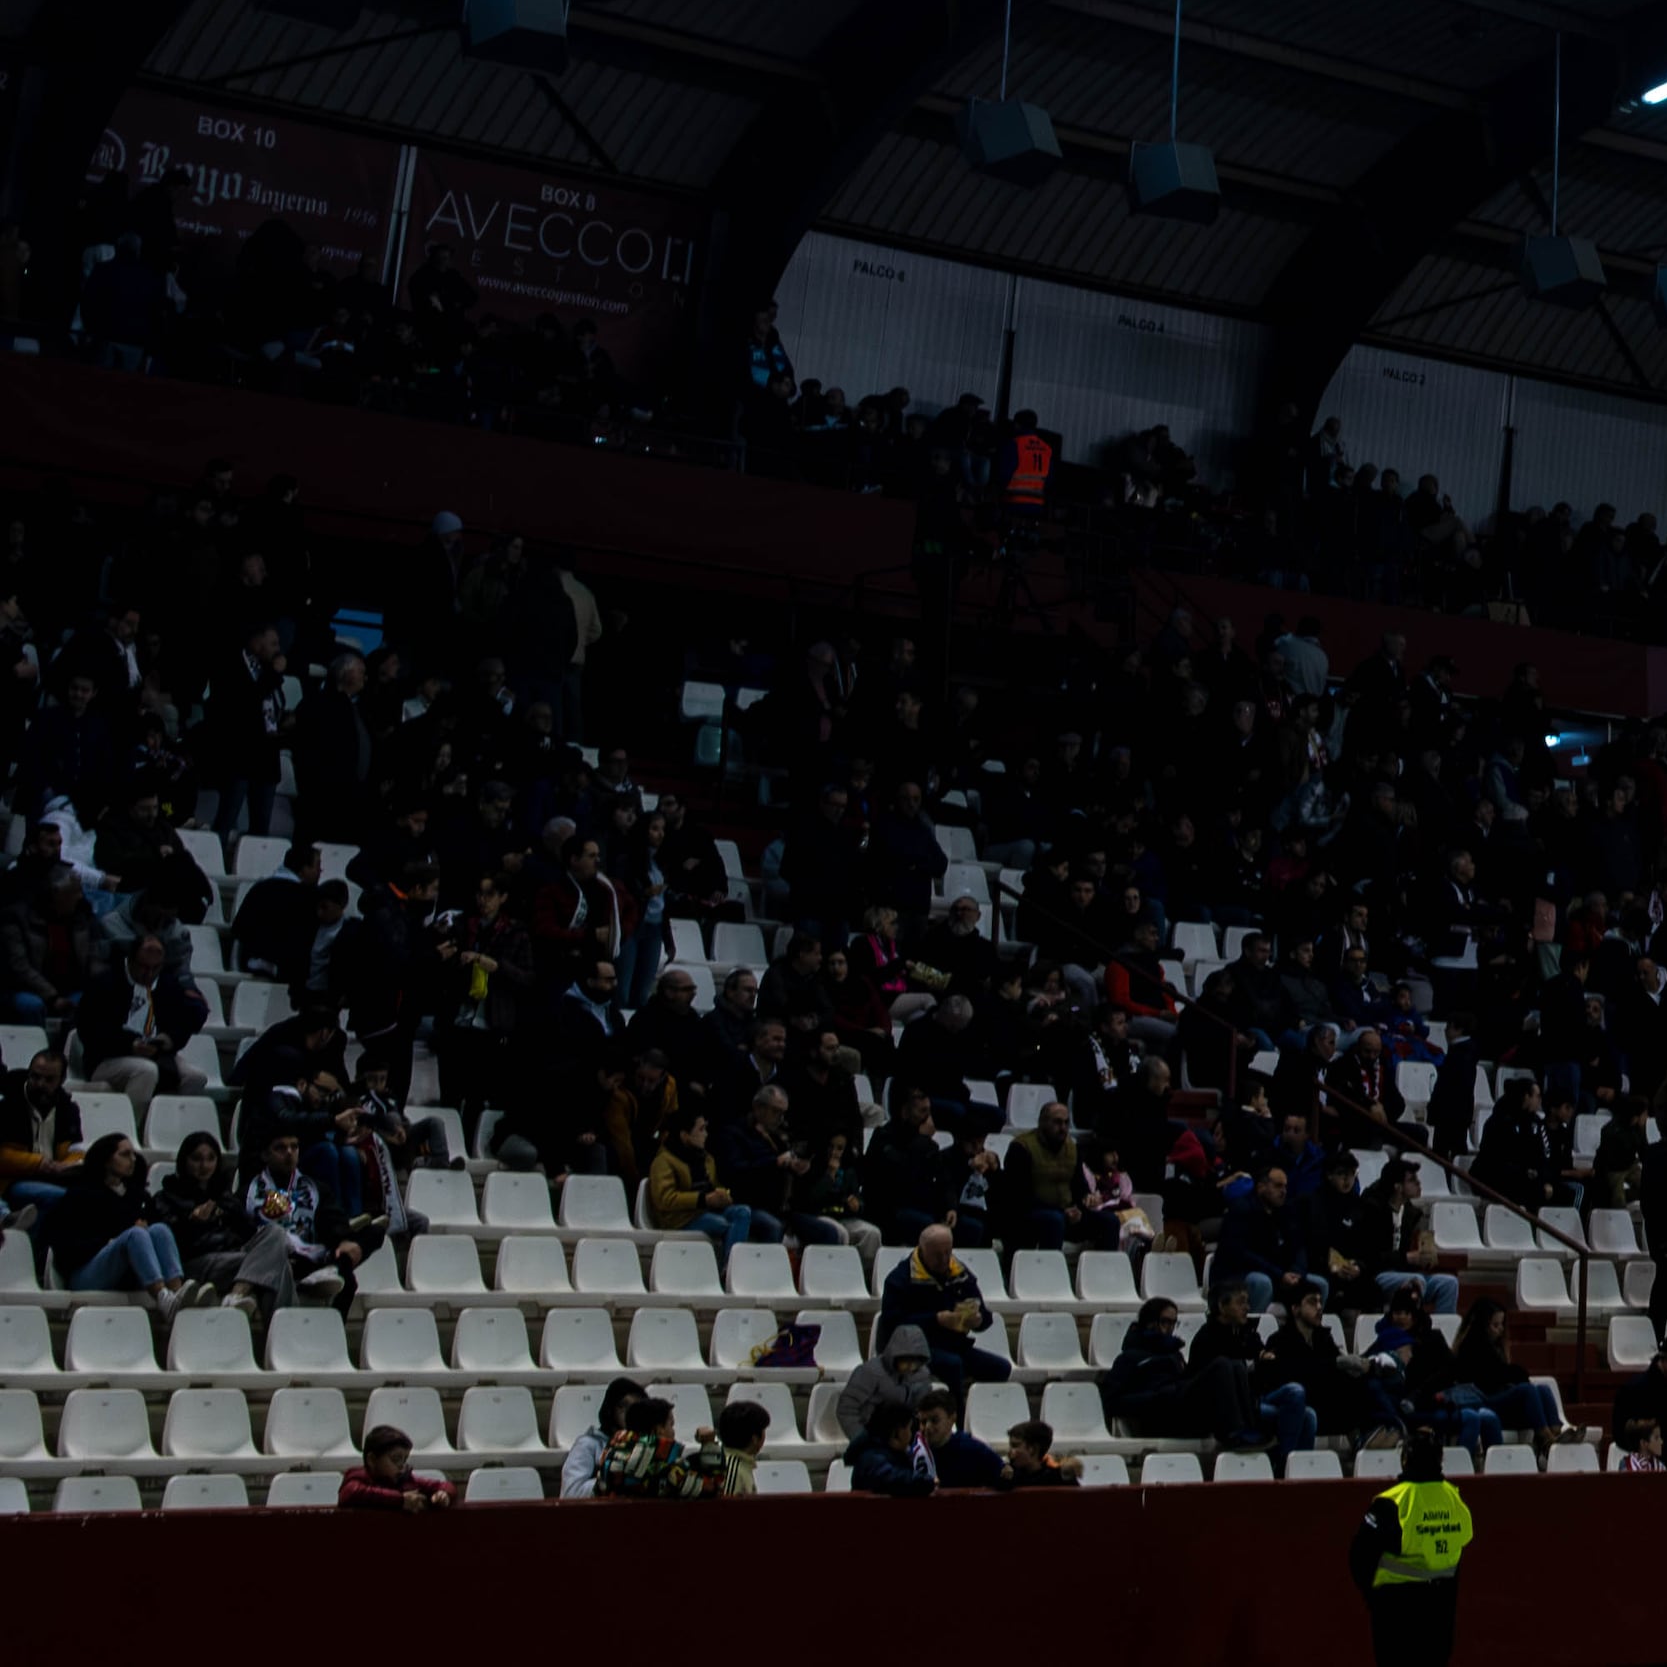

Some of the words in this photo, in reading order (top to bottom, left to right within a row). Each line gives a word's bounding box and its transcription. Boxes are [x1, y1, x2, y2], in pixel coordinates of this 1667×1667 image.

[197, 115, 245, 143] BOX
[253, 126, 276, 149] 10
[138, 141, 243, 206] Ryo
[540, 183, 581, 211] BOX
[586, 194, 597, 213] 8
[853, 257, 895, 281] PALCO
[475, 272, 630, 315] www.aveccogestion.com
[1117, 313, 1155, 333] PALCO
[1382, 367, 1417, 384] PALCO
